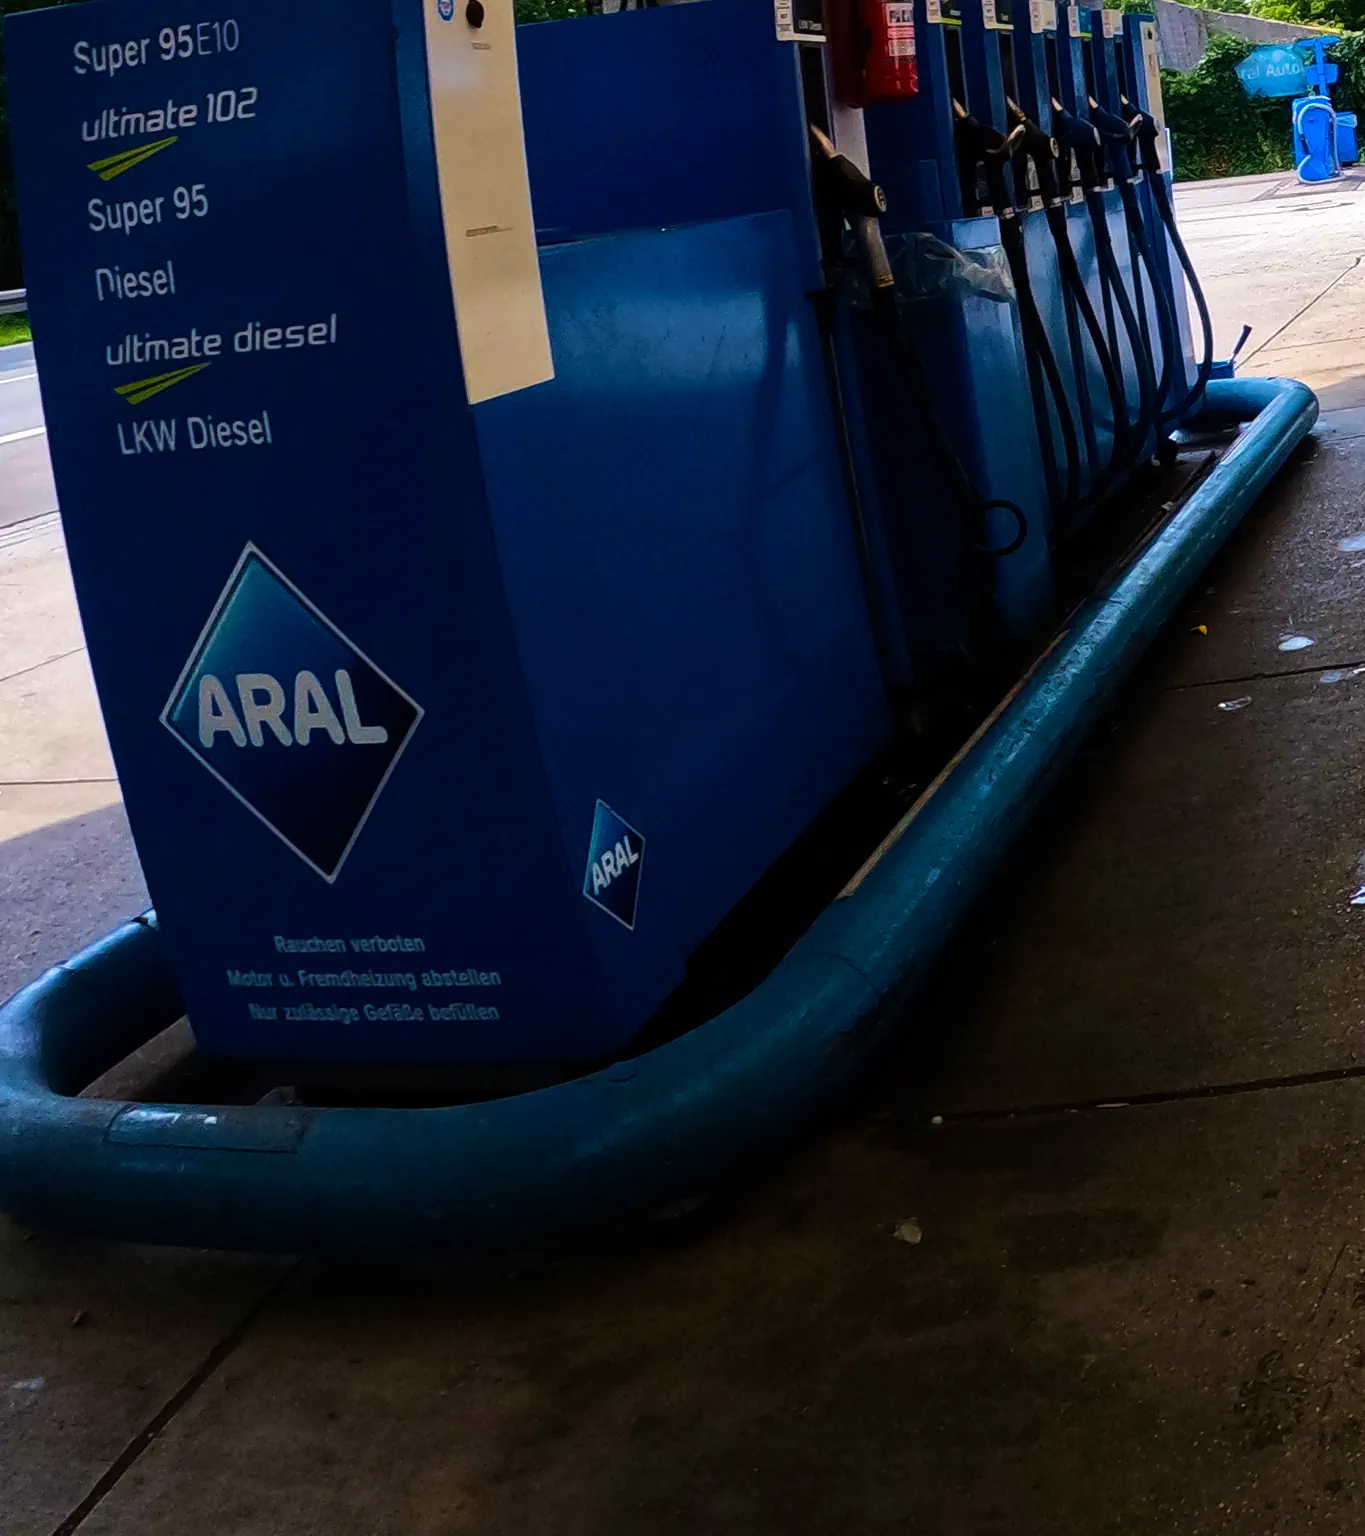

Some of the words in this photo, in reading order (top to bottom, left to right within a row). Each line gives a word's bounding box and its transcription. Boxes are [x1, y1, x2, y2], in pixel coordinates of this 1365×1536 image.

[74, 37, 150, 77] Super
[82, 98, 197, 142] ultimate
[206, 86, 258, 123] 102
[88, 197, 164, 235] Super
[173, 183, 209, 219] 95
[95, 260, 176, 301] Diesel
[106, 327, 222, 365] ultimate
[234, 313, 337, 353] diesel
[117, 417, 176, 455] LKW
[187, 410, 272, 449] Diesel
[196, 668, 389, 748] ARAL
[588, 834, 639, 897] ARAL
[272, 935, 347, 953] Rauchen
[350, 934, 426, 953] verboten
[225, 968, 272, 987] Motor
[278, 973, 294, 987] u.
[297, 968, 418, 992] Fremdheizung
[420, 968, 502, 987] abstellen
[247, 1002, 278, 1021] Nur
[283, 1002, 360, 1025] zulässige
[364, 1003, 425, 1021] Gefäße
[428, 1002, 500, 1021] befüllen
